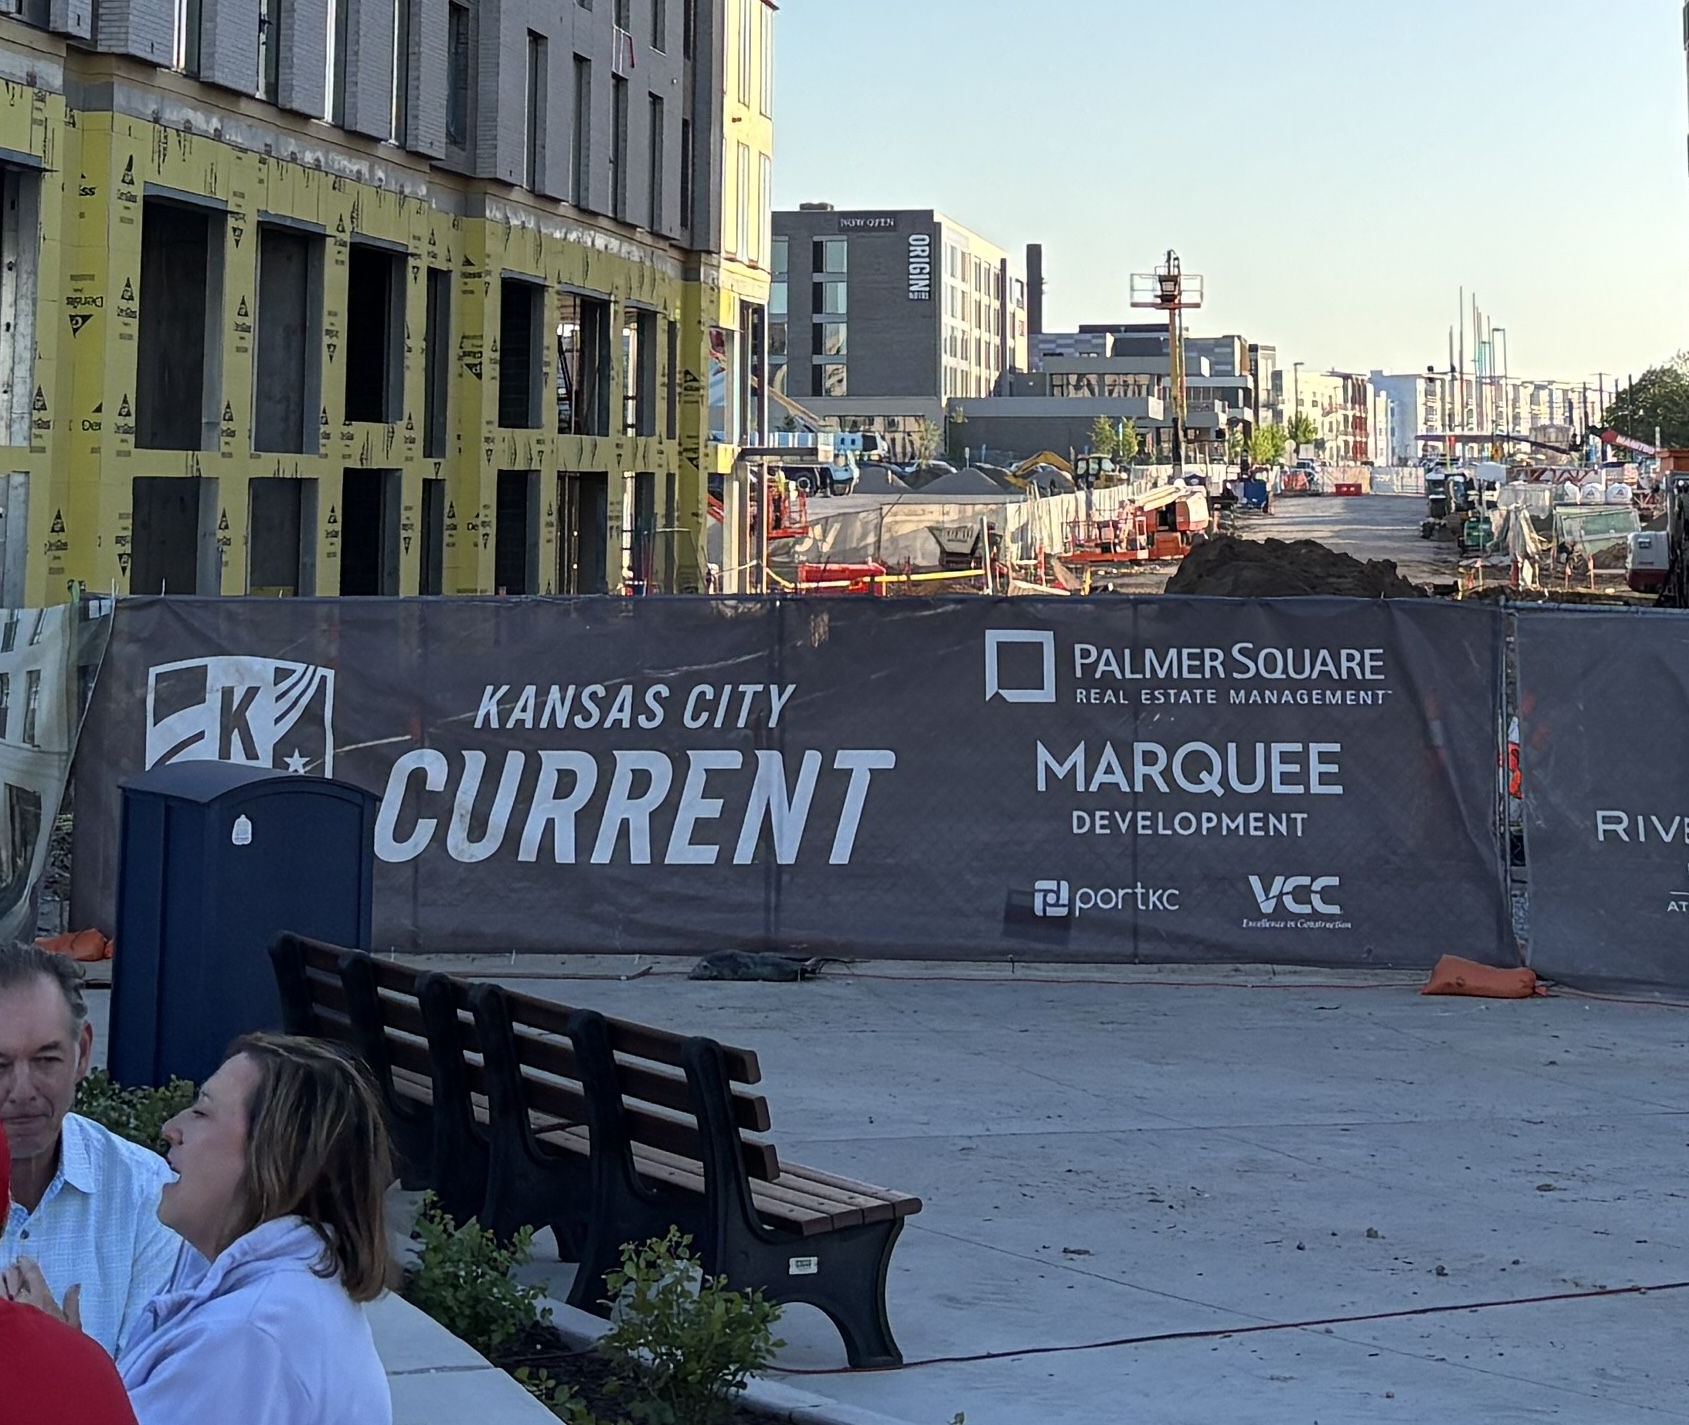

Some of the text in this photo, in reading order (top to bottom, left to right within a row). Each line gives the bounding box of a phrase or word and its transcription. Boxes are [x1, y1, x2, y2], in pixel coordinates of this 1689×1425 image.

[908, 233, 931, 292] ORIGIN
[1073, 641, 1386, 681] PALMER SQUARE
[473, 682, 798, 731] KANSAS CITY
[1075, 688, 1388, 706] REAL ESTATE MANAGEMENT
[1035, 739, 1344, 798] MARQUEE
[372, 747, 898, 867] CURRENT
[1072, 810, 1309, 838] DEVELOPMENT
[1247, 874, 1342, 915] VCC
[1666, 900, 1689, 913] AT
